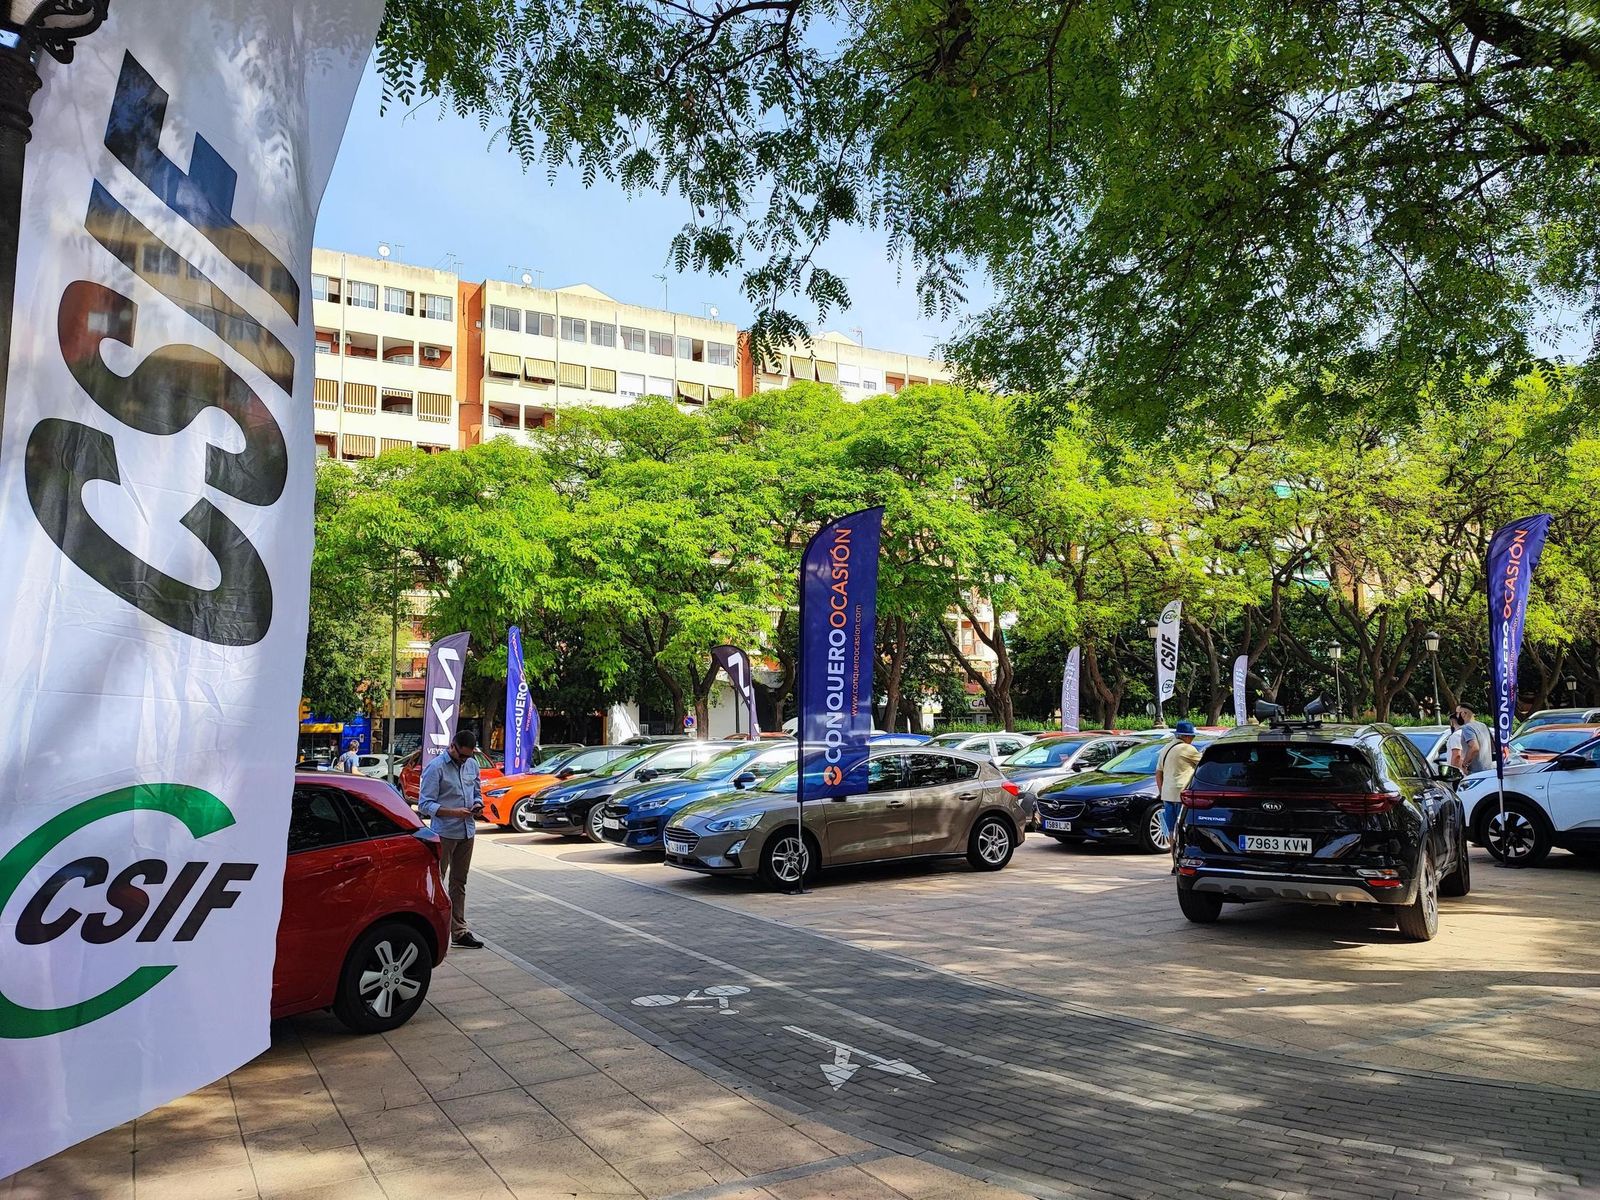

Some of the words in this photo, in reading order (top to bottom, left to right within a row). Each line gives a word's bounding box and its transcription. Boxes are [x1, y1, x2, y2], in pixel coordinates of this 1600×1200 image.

[25, 48, 300, 647] CSIF
[824, 528, 852, 763] CONQUEROOCASIÓN
[850, 604, 862, 718] www.conqueroocasion.com
[1161, 633, 1177, 672] CSIF
[1247, 837, 1279, 849] 7963
[1283, 838, 1308, 852] KVW
[15, 856, 259, 945] CSIF
